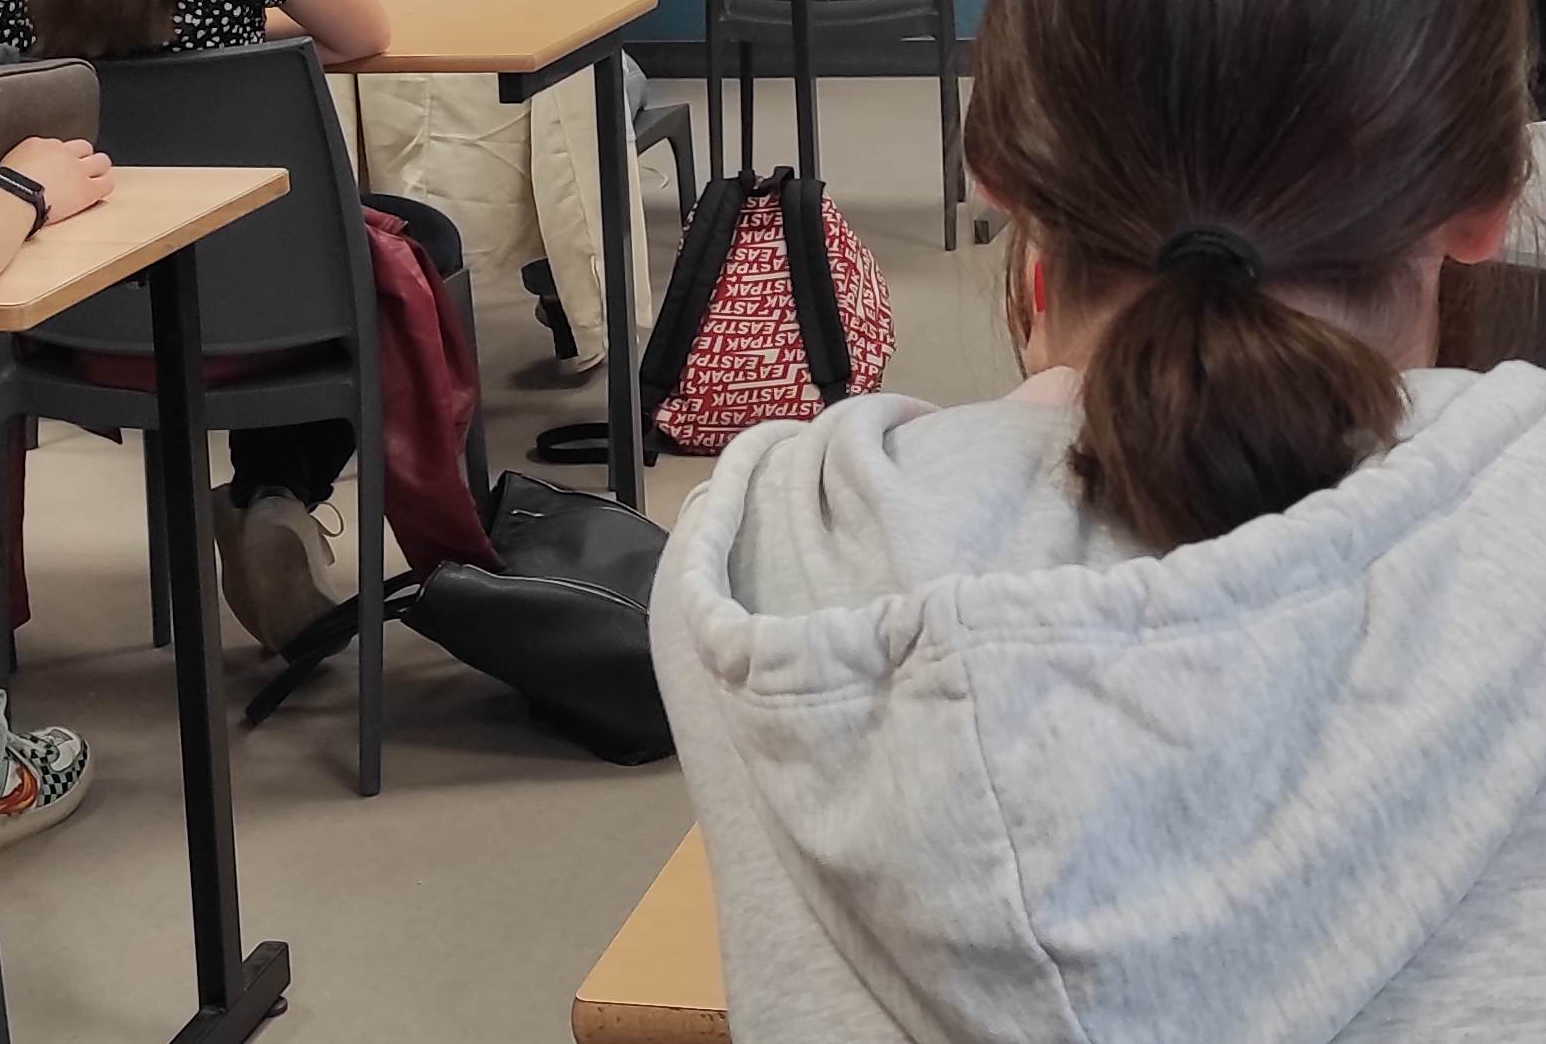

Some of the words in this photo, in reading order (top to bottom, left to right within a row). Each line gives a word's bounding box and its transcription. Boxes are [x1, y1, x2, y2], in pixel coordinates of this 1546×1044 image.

[739, 212, 783, 228] EAST
[739, 227, 784, 244] TPAK
[726, 248, 773, 262] EAST
[720, 256, 789, 275] ASTPA
[725, 280, 792, 297] STPAK
[702, 320, 775, 334] EASTPA
[727, 330, 803, 350] ASTPAK
[686, 353, 759, 369] EASTPA
[698, 365, 784, 384] EASTPAK
[711, 385, 798, 406] EASTPAK
[752, 402, 825, 418] ASTPAK
